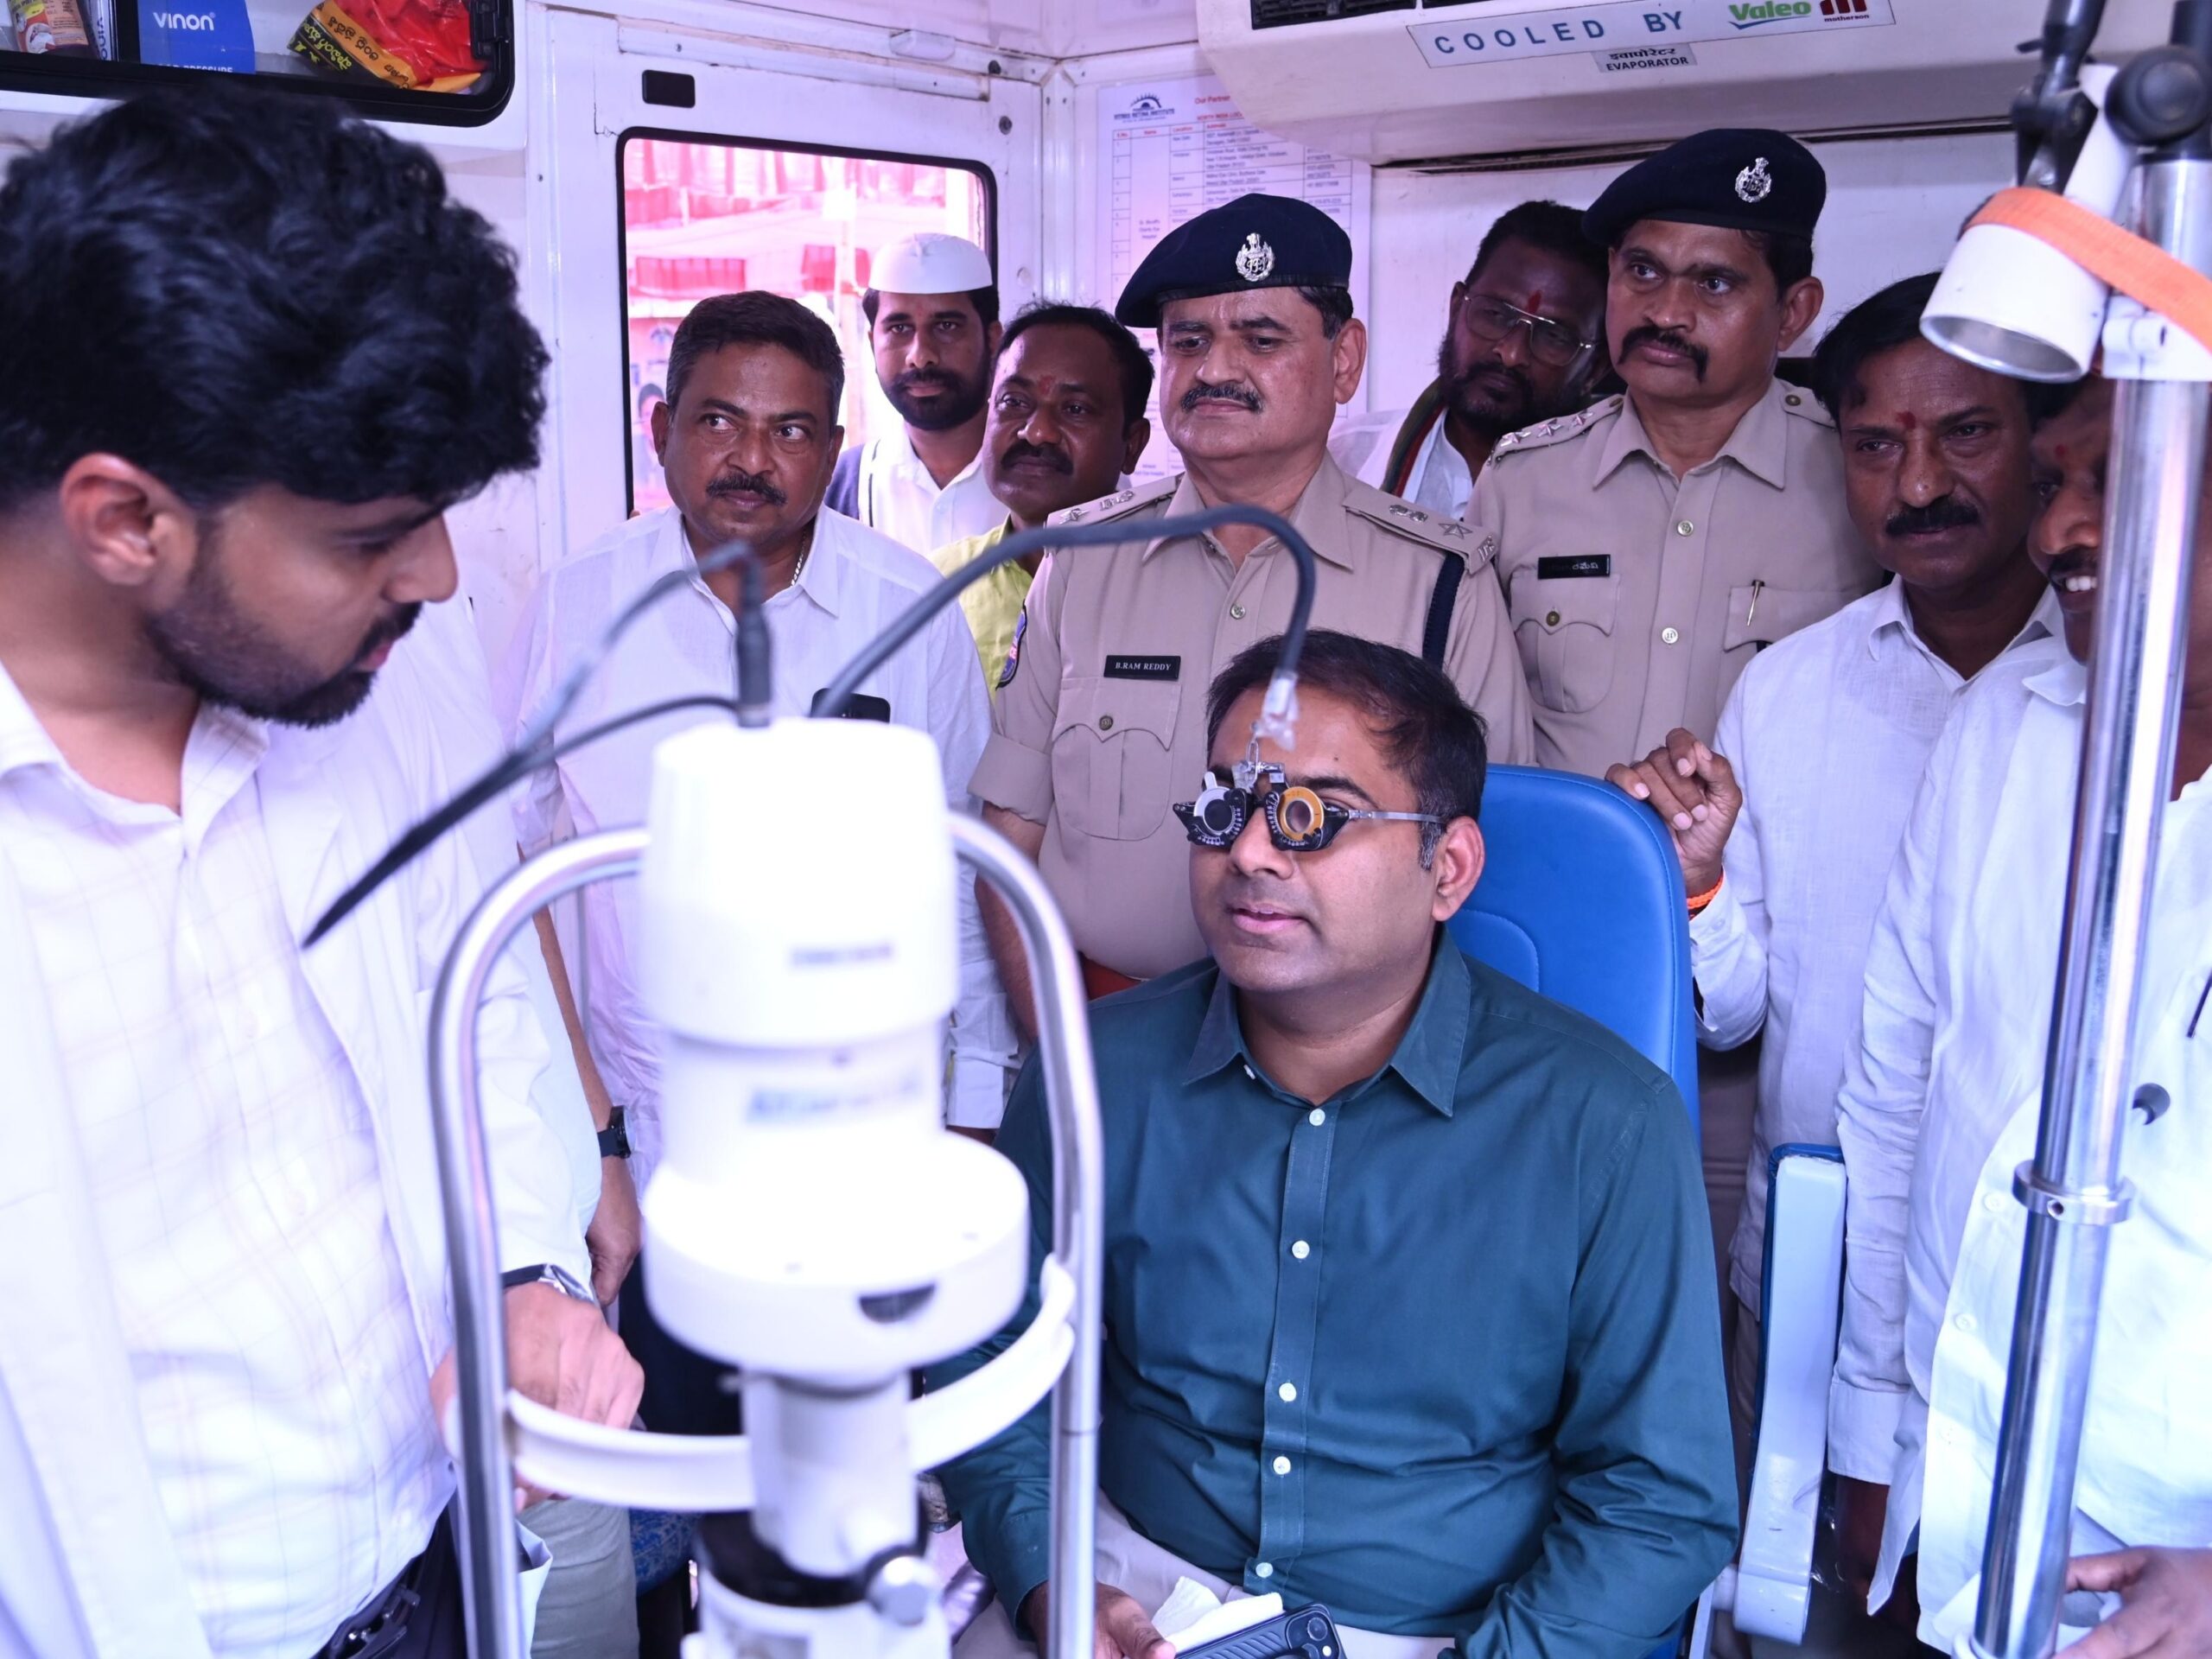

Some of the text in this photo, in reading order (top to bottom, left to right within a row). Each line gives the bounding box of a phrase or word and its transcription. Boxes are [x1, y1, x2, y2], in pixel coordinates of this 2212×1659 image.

[1729, 1, 1811, 22] Valeo
[1824, 14, 1870, 22] motherson
[1434, 10, 1682, 54] COOLED BY
[1606, 56, 1688, 71] EVAPORATOR
[1115, 662, 1172, 671] B.RAM REDDY
